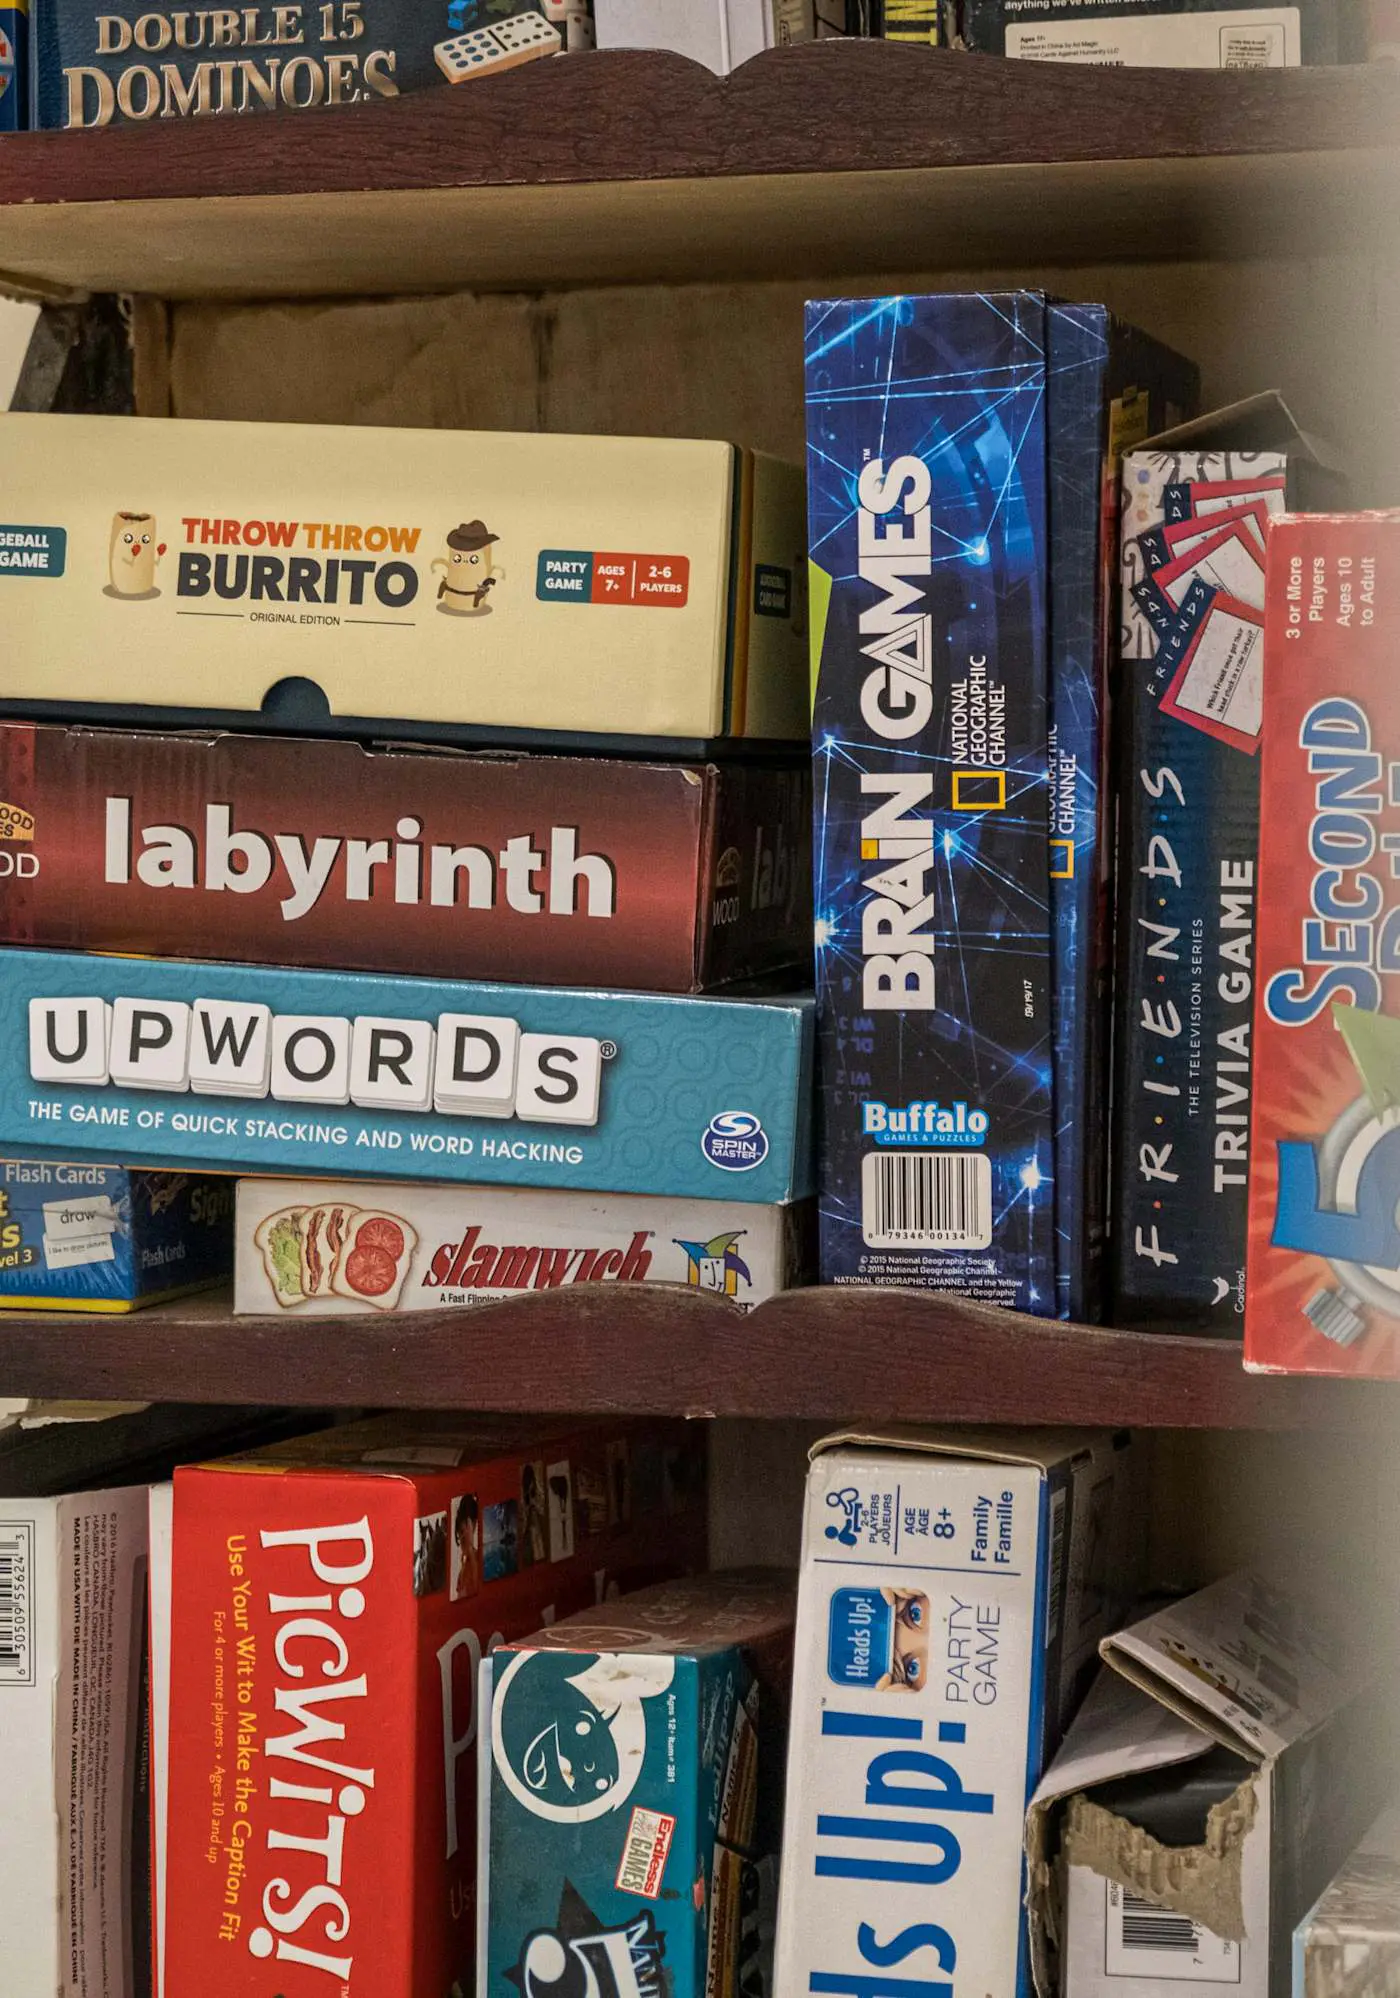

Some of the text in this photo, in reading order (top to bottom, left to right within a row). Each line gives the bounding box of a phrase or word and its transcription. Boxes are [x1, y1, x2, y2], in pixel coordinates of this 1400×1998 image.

[96, 2, 366, 54] DOUBLE 15
[63, 50, 400, 130] DOMINOES
[181, 518, 422, 554] THROW THROW
[0, 551, 49, 569] GAME
[545, 560, 588, 575] PARTY
[598, 564, 626, 577] AGES
[648, 565, 673, 579] 2-6
[176, 551, 419, 608] BURRITO
[544, 577, 584, 592] GAME
[604, 579, 620, 592] 7+
[639, 581, 683, 595] PLAYERS
[1308, 557, 1328, 622] Players
[1335, 557, 1355, 628] Ages 10
[1359, 556, 1375, 626] to Adult
[1285, 556, 1302, 640] 3 or More
[249, 611, 341, 626] ORIGINAL EDITION
[951, 678, 969, 765] NATIONAL
[970, 655, 988, 766] GEOGRAPHIC
[104, 796, 615, 921] labyrinth
[1188, 918, 1204, 1117] THE TELEVISION SERIES
[1213, 859, 1254, 1193] TRIVIA GAME
[28, 1100, 584, 1165] THE GAME OF QUICK STACKING AND WORD HACKING
[865, 1103, 988, 1134] Buffalo
[711, 1139, 757, 1152] SPIN
[884, 1133, 918, 1142] GAMES
[932, 1133, 978, 1143] PUZZLES
[5, 1163, 107, 1185] Flash Cards
[60, 1208, 98, 1226] draw
[868, 1232, 874, 1240] 0
[888, 1231, 925, 1241] 79346
[929, 1231, 967, 1241] 00134
[23, 1248, 33, 1264] 3
[867, 1265, 965, 1276] 2015 National Geographic
[869, 1255, 966, 1267] 2015 National Geographic
[439, 1292, 466, 1304] A Fast
[833, 1276, 1023, 1288] NATIONAL GEOGRAPHIC CHANNEL and the Yellow
[973, 1288, 1017, 1299] Geographic
[1233, 1270, 1245, 1314] Cardinal
[73, 1517, 81, 1551] MADE
[860, 1509, 869, 1527] 2-6
[868, 1493, 880, 1544] PLAYERS
[881, 1493, 892, 1546] JOUEURS
[904, 1507, 916, 1536] AGE
[933, 1507, 955, 1540] 8+
[970, 1495, 994, 1563] Family
[994, 1490, 1013, 1565] Famille
[73, 1553, 81, 1566] IN
[14, 1556, 25, 1601] 55624
[73, 1568, 81, 1593] USA
[73, 1595, 81, 1624] WITH
[14, 1607, 26, 1652] 30509
[73, 1625, 81, 1645] DIE
[845, 1596, 877, 1678] Heads Up!
[945, 1594, 973, 1703] PARTY
[972, 1604, 1001, 1706] GAME
[17, 1668, 26, 1676] 6
[72, 1683, 79, 1696] IN
[666, 1693, 677, 1716] Ages
[205, 1610, 227, 1864] For 4 or more players Ages 10 and up
[217, 1534, 259, 1942] Use Your Wit to Make the Caption Fit
[667, 1763, 676, 1783] 381
[70, 1802, 78, 1826] AUX
[814, 1710, 995, 1886] Up!
[620, 1837, 653, 1890] GAMES
[643, 1818, 672, 1894] Endless
[71, 1931, 79, 1948] EN
[72, 1949, 80, 1985] CHINE
